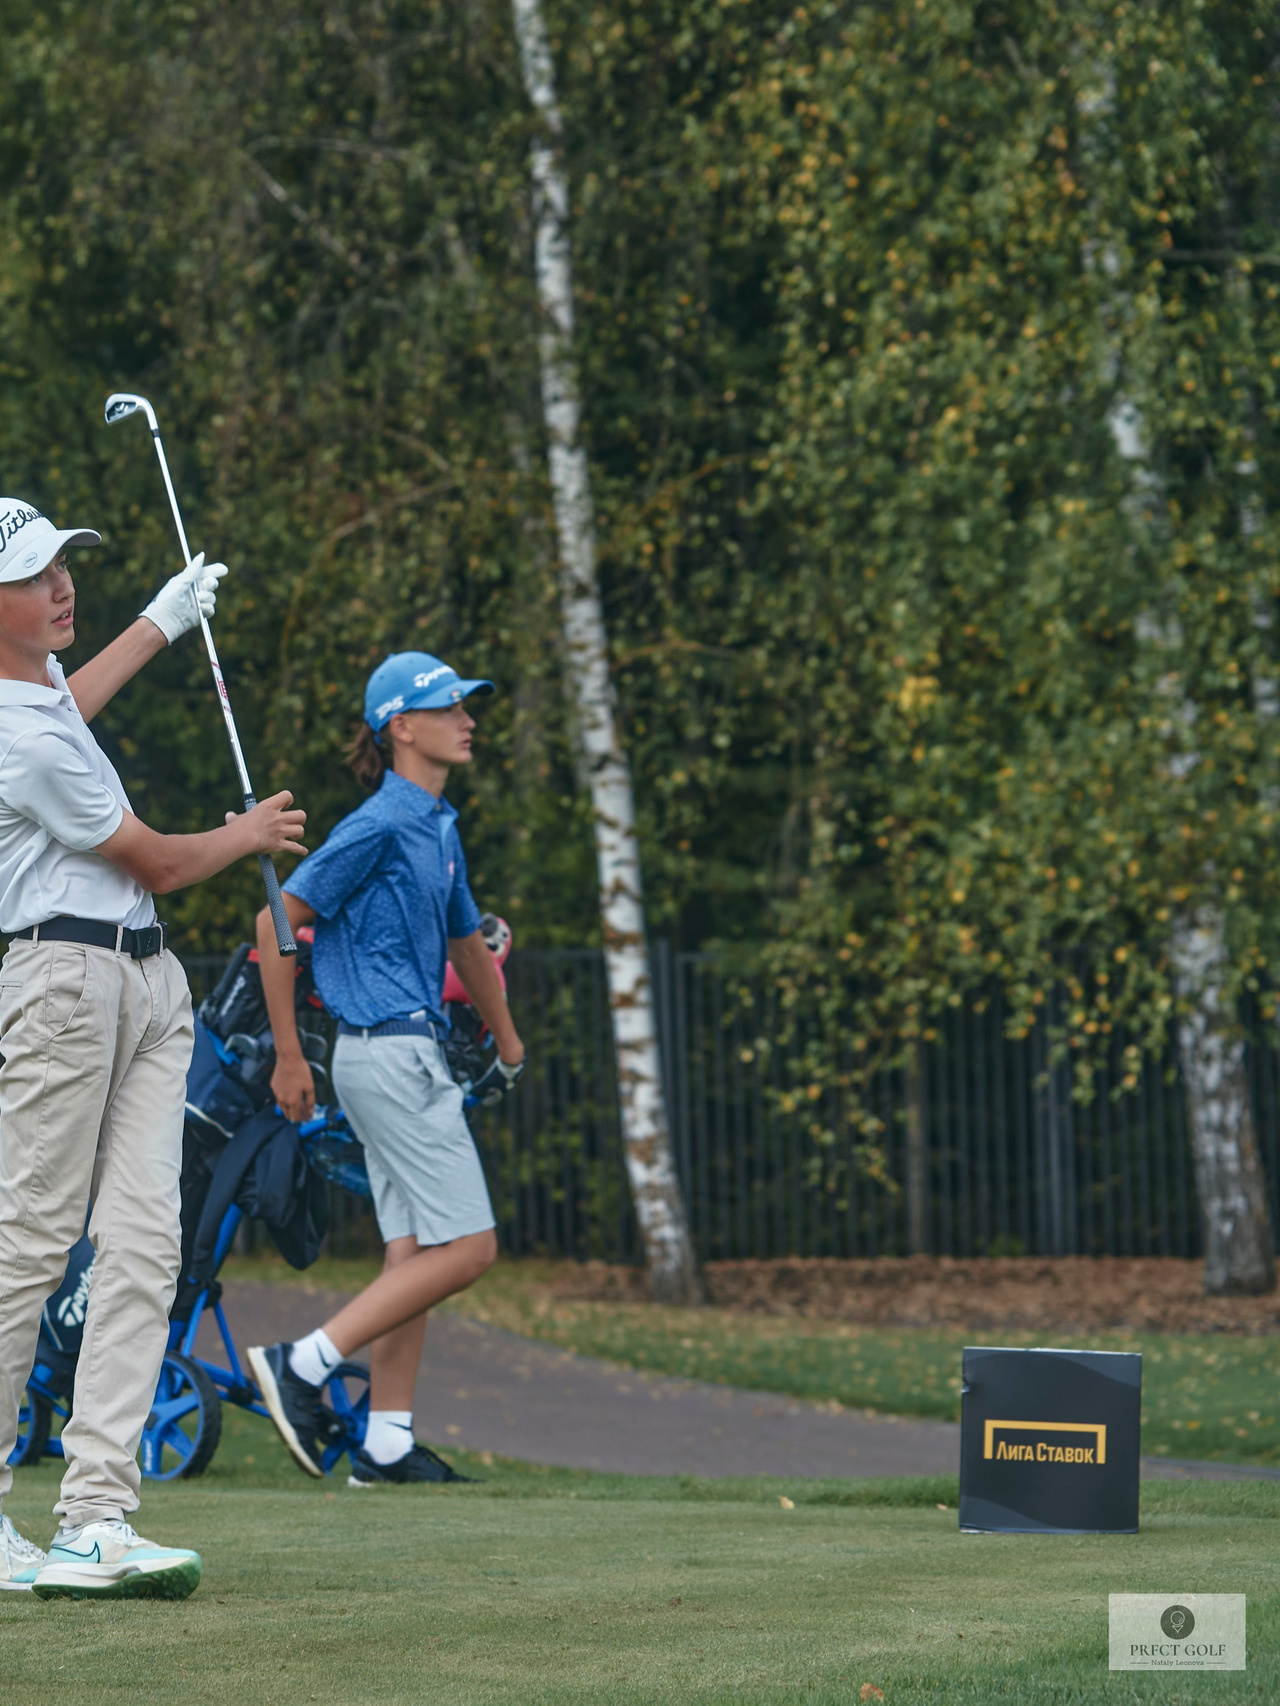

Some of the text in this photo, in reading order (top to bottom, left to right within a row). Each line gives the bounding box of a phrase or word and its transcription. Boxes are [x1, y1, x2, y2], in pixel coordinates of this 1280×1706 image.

[57, 1250, 96, 1327] Taylo
[996, 1441, 1094, 1464] Лига Ставок
